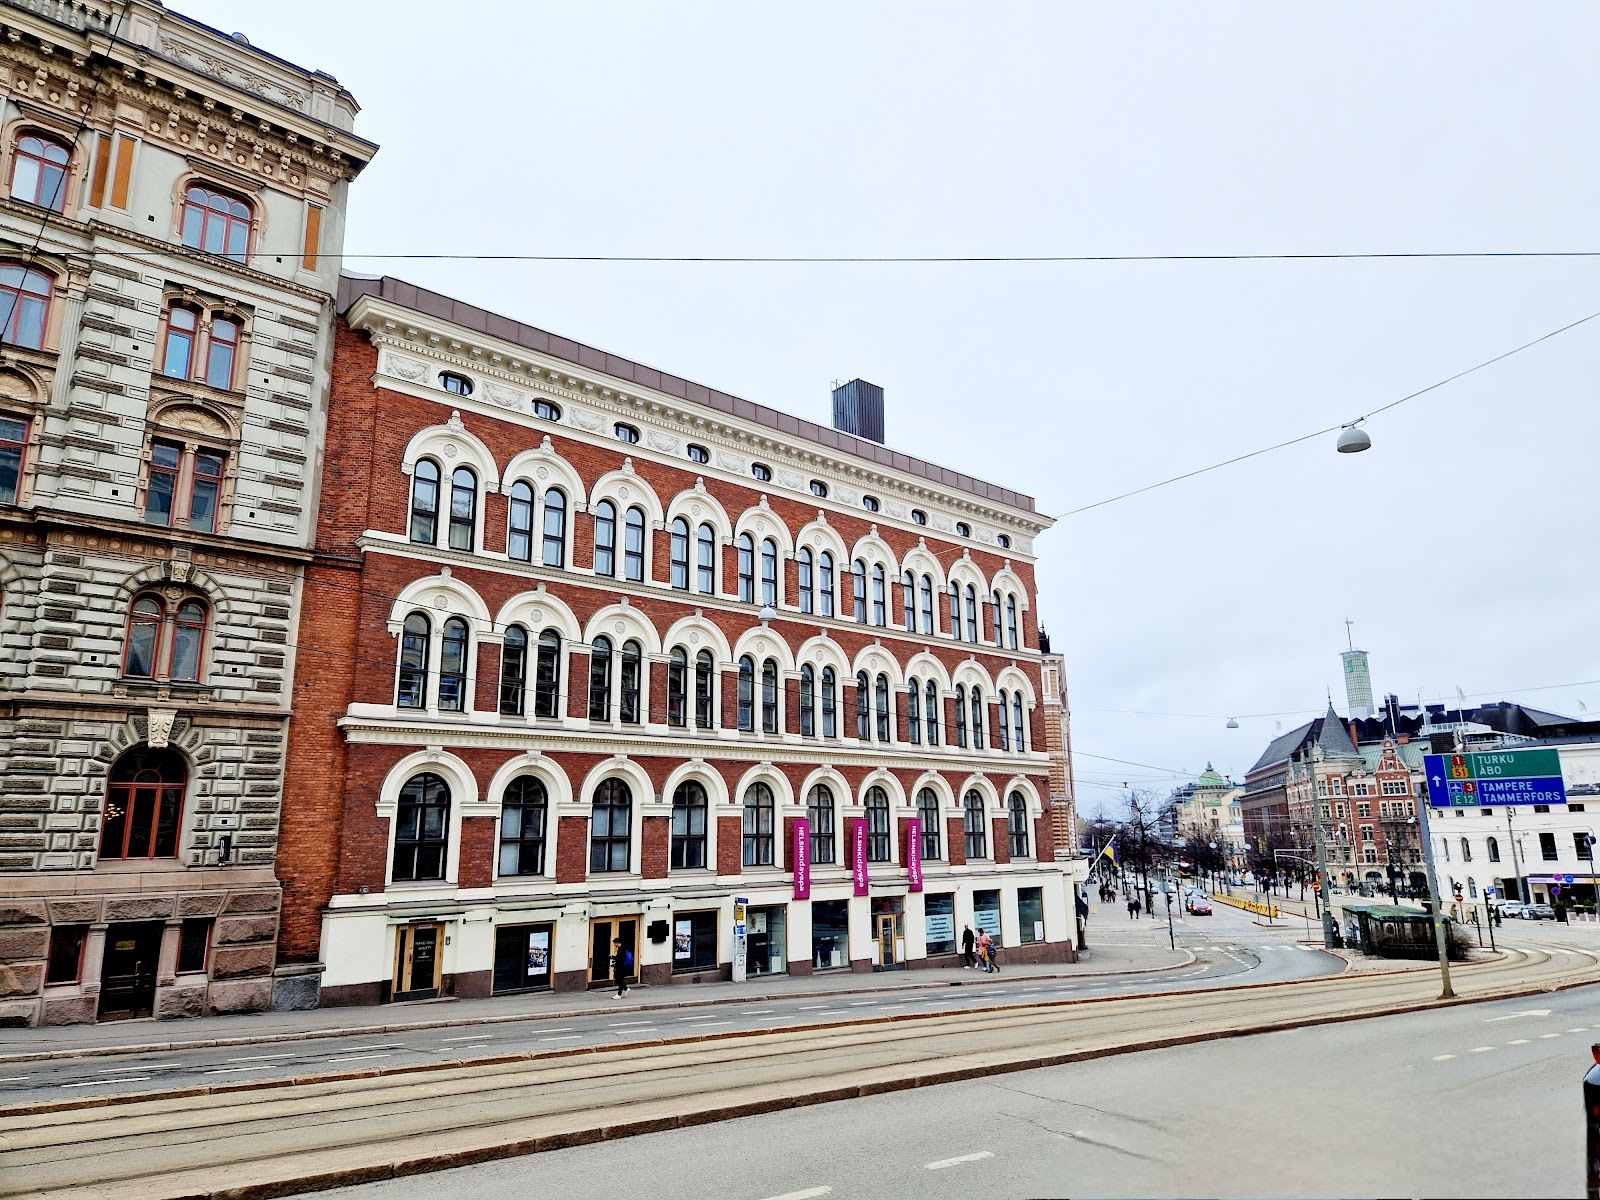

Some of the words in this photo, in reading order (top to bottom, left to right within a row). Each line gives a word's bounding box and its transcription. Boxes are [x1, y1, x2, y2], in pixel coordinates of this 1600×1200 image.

[1477, 754, 1515, 765] TURKU
[1455, 768, 1467, 777] 51
[1479, 765, 1502, 775] ÅBO
[1467, 783, 1473, 792] 3
[1481, 781, 1534, 792] TAMPERE
[1483, 791, 1561, 803] TAMMERFORS
